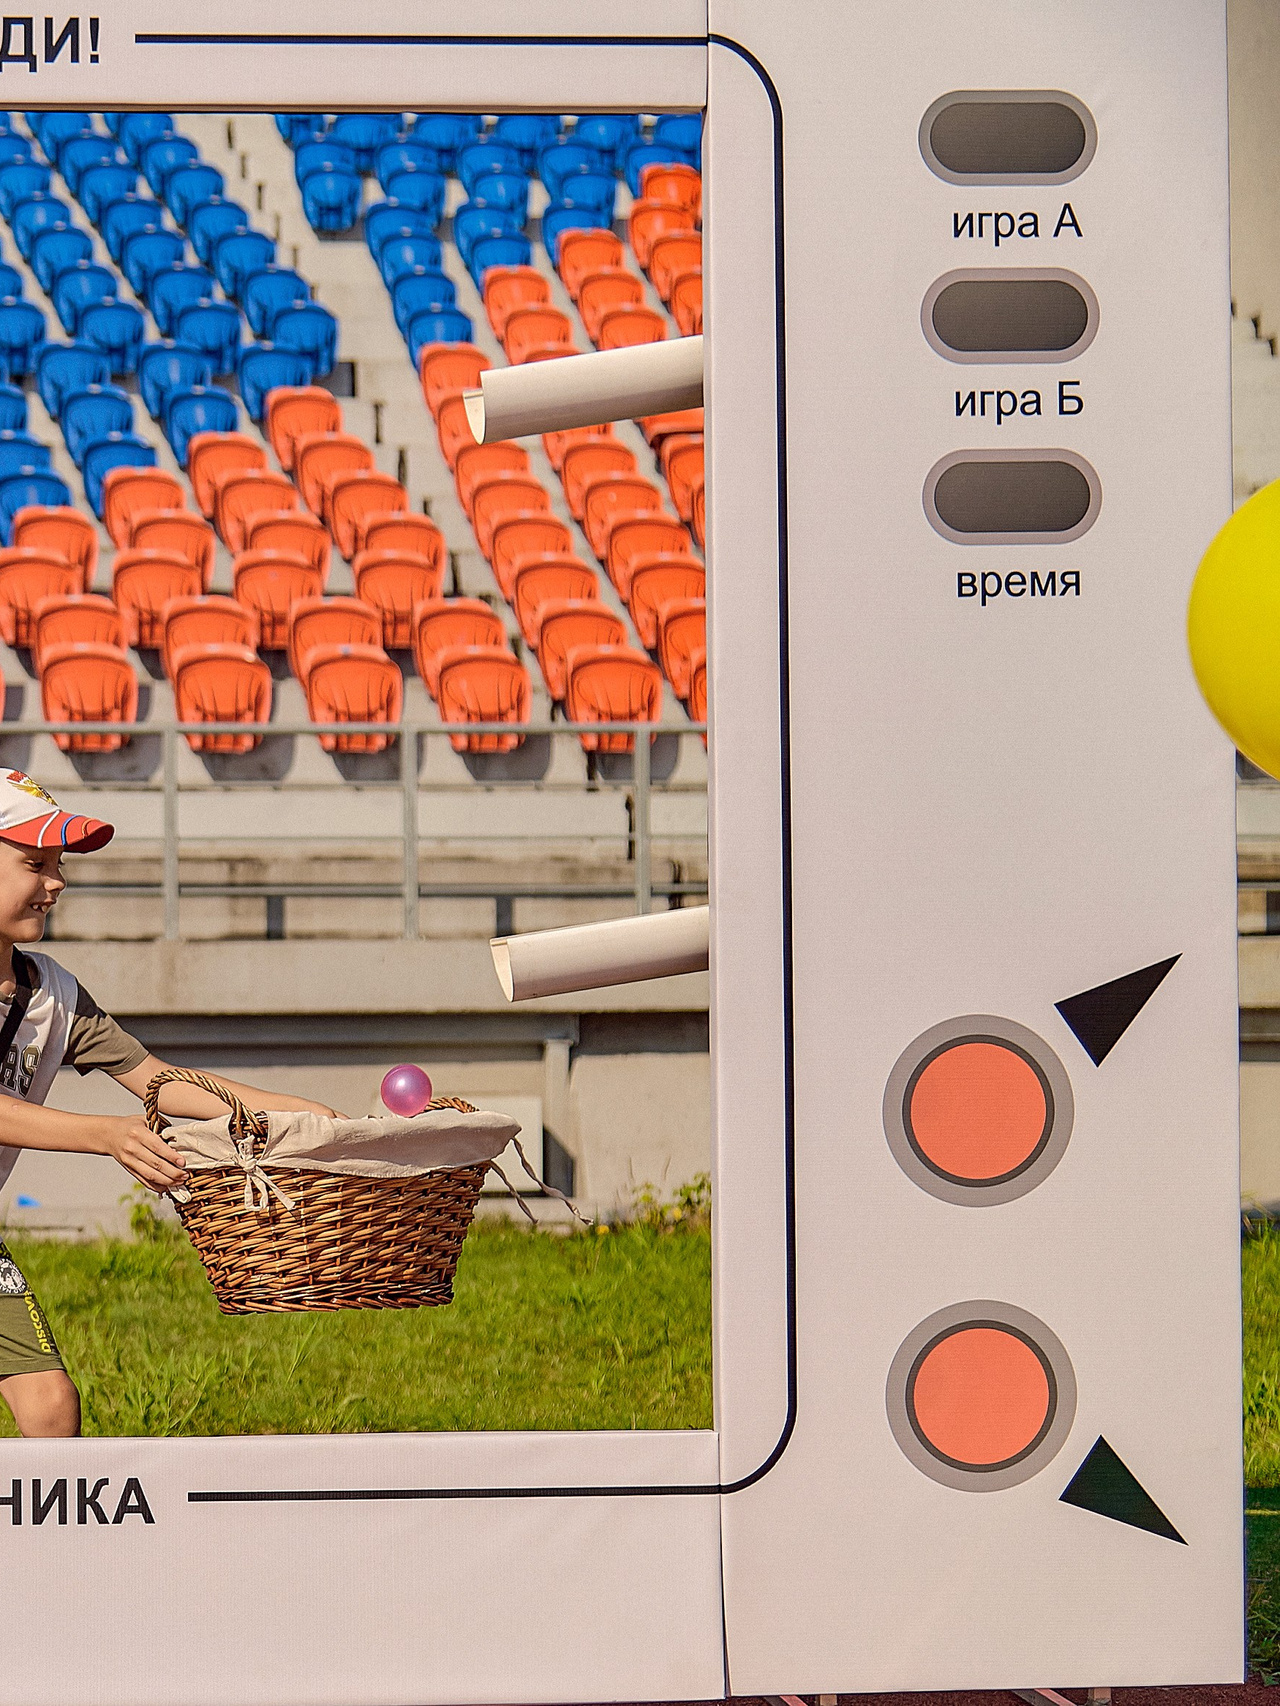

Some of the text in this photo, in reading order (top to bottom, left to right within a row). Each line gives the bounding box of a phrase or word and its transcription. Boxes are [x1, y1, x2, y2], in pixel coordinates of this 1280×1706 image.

[952, 202, 1083, 247] игра А
[954, 380, 1084, 426] игра Б
[956, 569, 1082, 607] время
